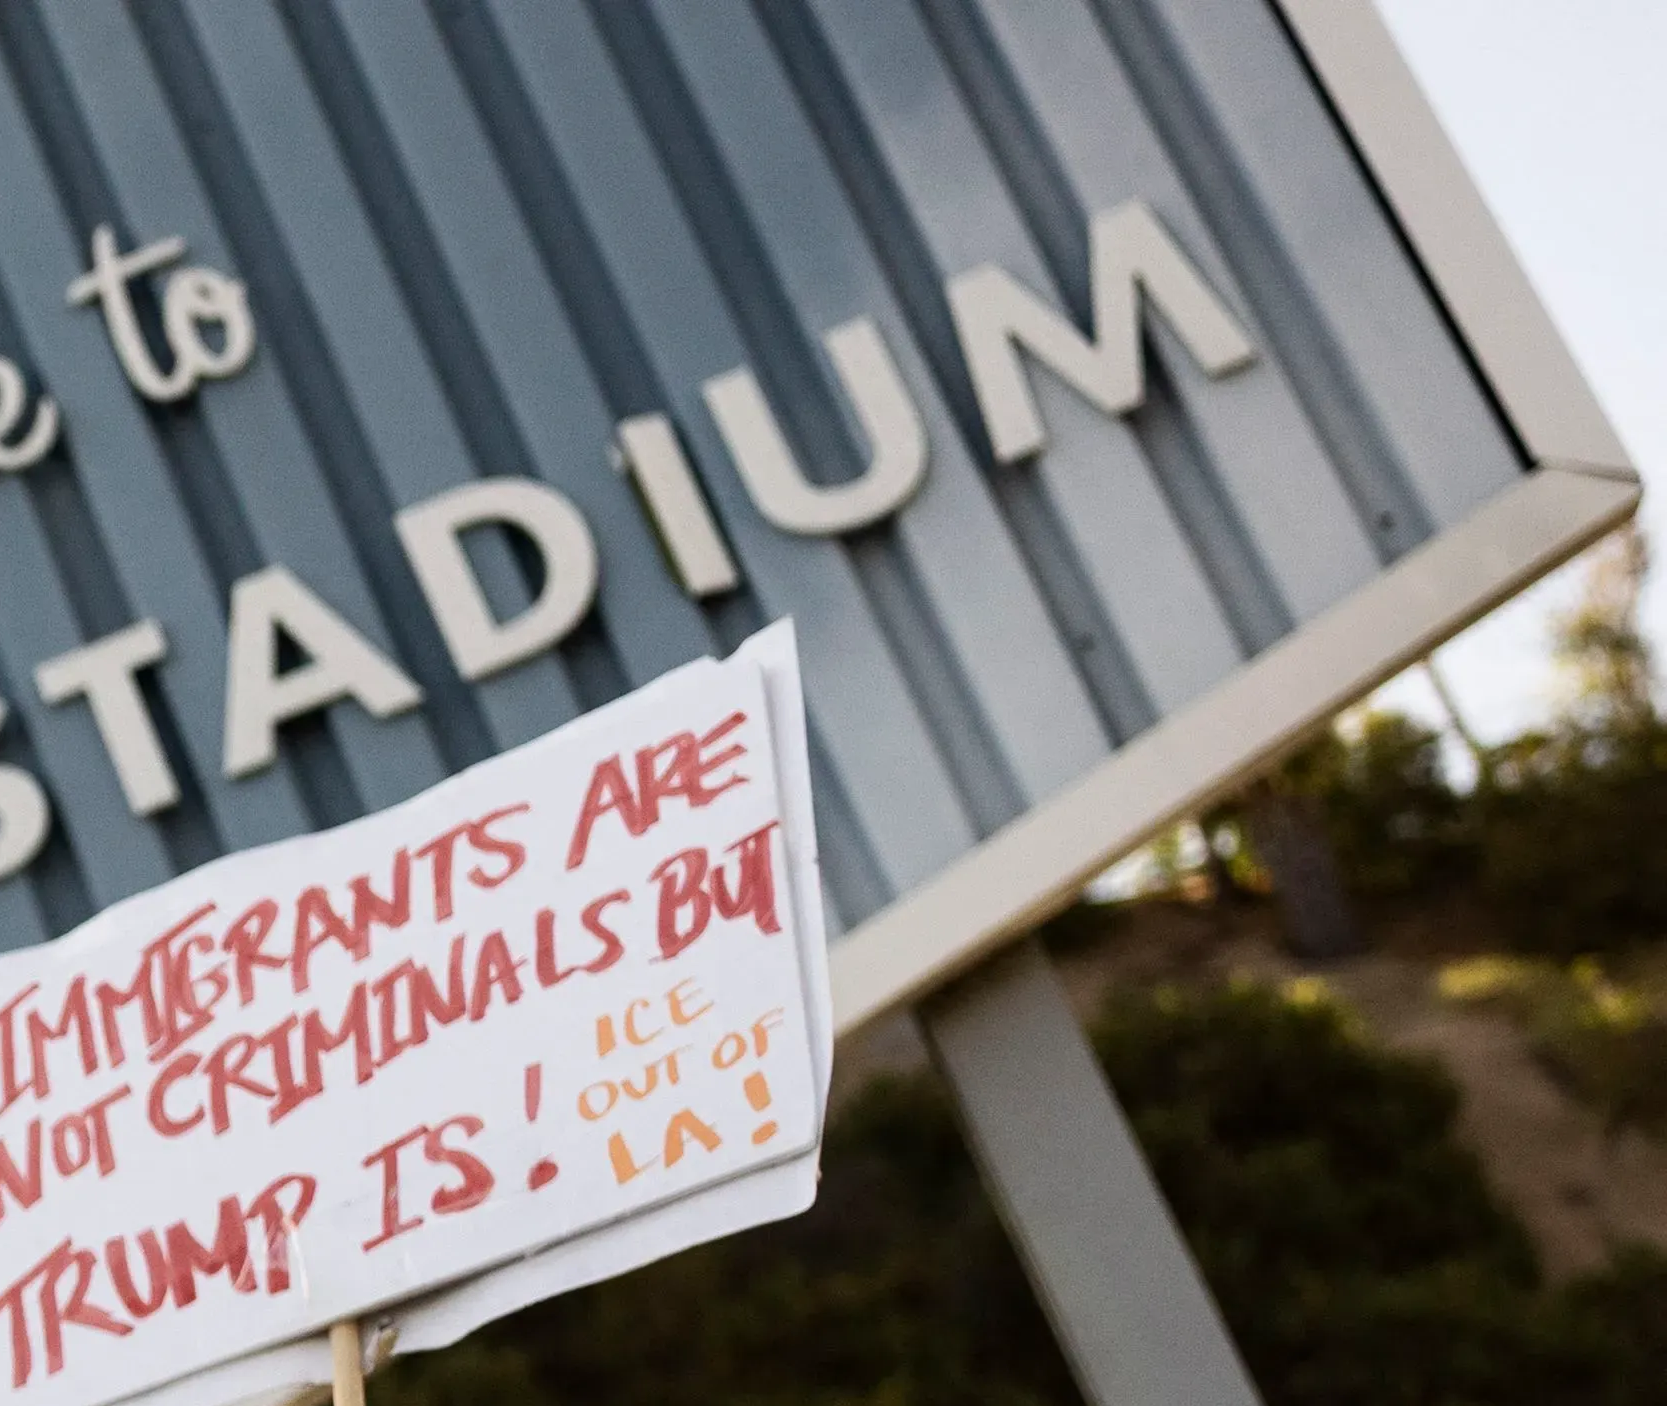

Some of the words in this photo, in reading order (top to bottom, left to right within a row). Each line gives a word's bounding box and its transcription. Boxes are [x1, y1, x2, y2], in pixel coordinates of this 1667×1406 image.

[67, 223, 257, 401] to
[565, 710, 751, 870] ARE
[146, 889, 632, 1138] CRIMINALS
[649, 819, 782, 966] BUT
[595, 977, 715, 1059] ICE
[576, 1042, 695, 1122] OUT
[712, 1005, 785, 1070] OF
[607, 1070, 779, 1185] LA!
